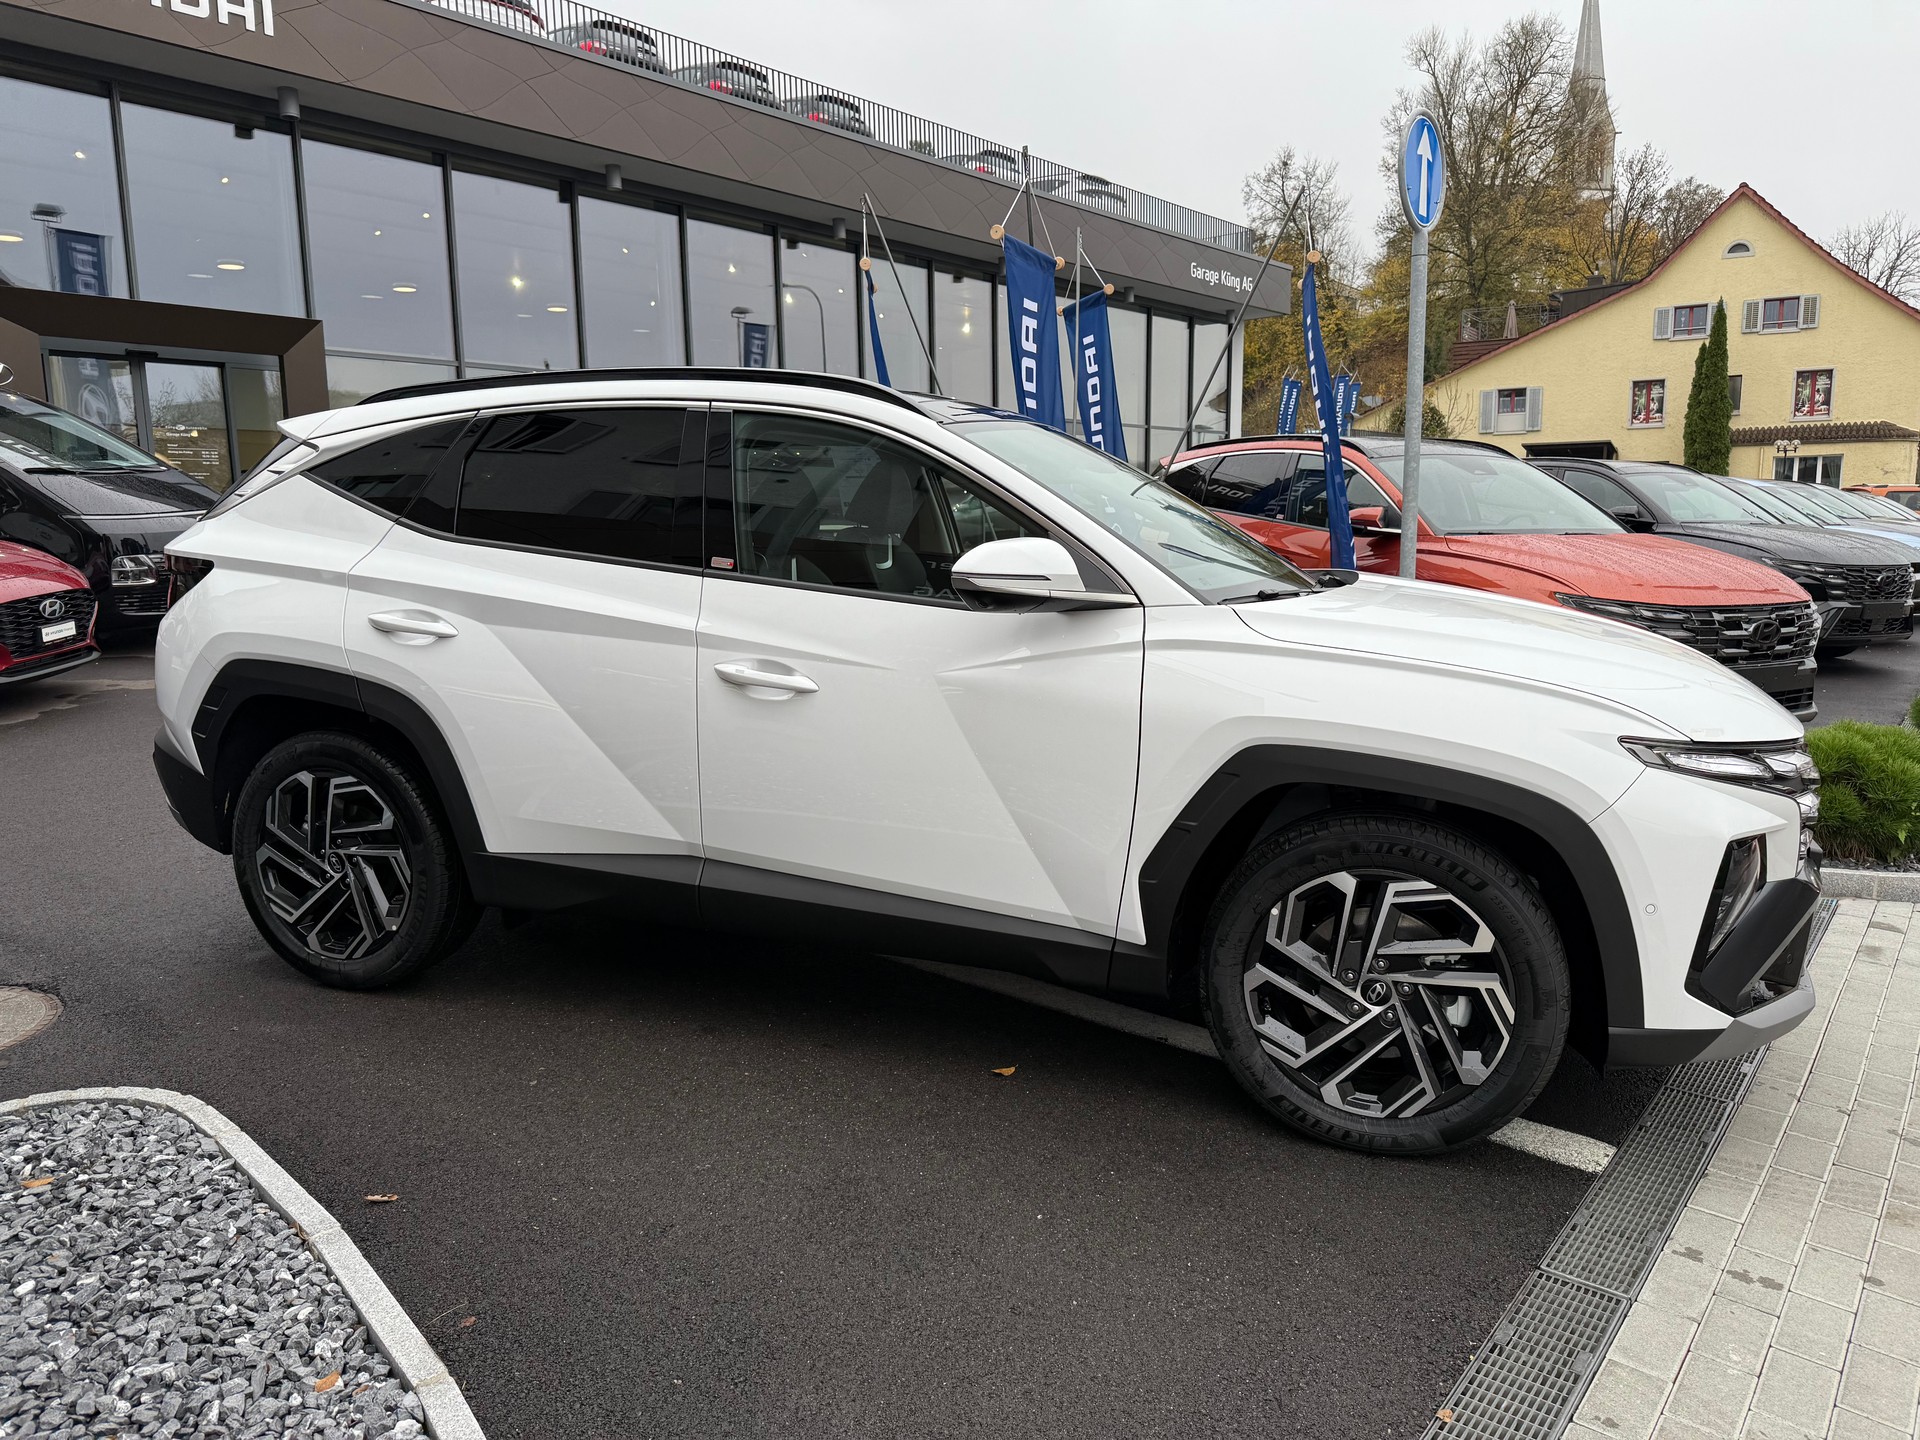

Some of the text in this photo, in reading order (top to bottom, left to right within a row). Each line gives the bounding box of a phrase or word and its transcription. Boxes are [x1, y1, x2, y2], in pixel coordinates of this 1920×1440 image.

[1190, 262, 1219, 286] Garage
[1242, 276, 1253, 292] AG
[1364, 840, 1483, 889] MICHELIN
